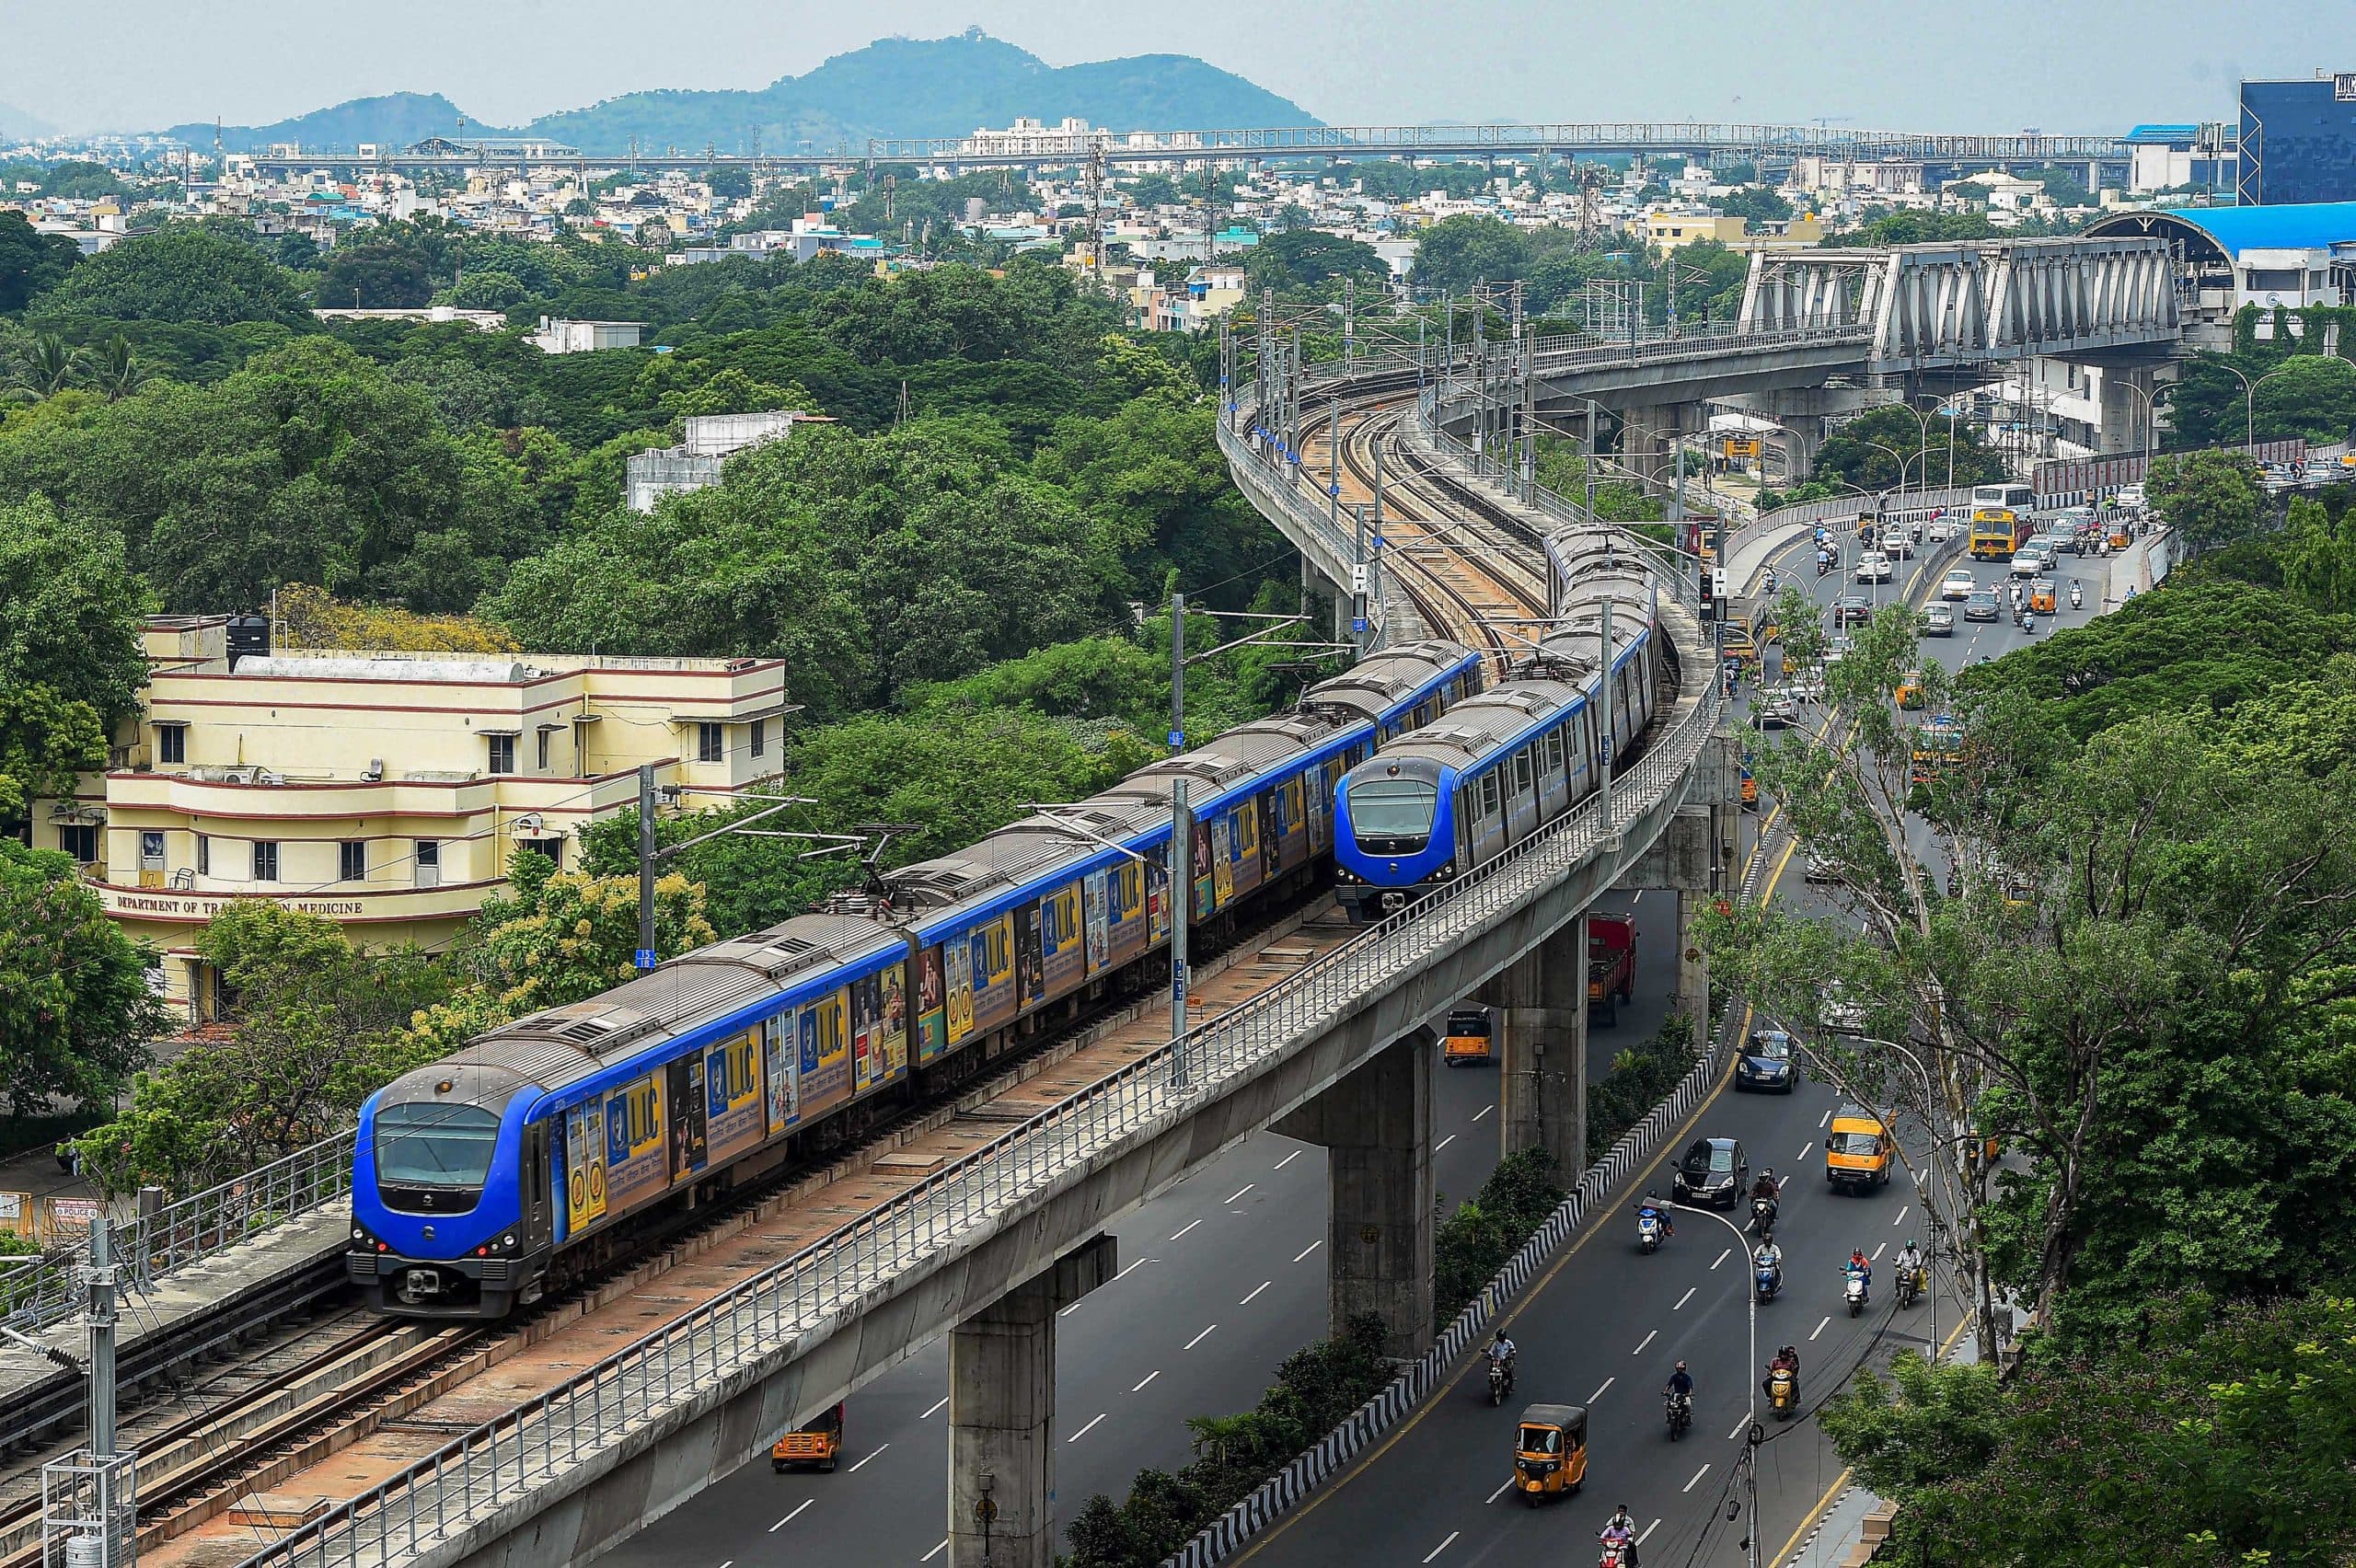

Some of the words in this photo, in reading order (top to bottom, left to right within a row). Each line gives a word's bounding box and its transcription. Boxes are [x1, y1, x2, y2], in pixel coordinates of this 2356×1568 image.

[117, 896, 179, 913] DEPARTMENT
[183, 902, 198, 914] OF
[298, 903, 363, 915] MEDICINE
[988, 927, 1009, 977] LIC
[819, 1003, 843, 1058] LIC
[729, 1043, 755, 1101] LIC
[630, 1088, 659, 1147] LIC
[64, 1207, 89, 1216] POLICE
